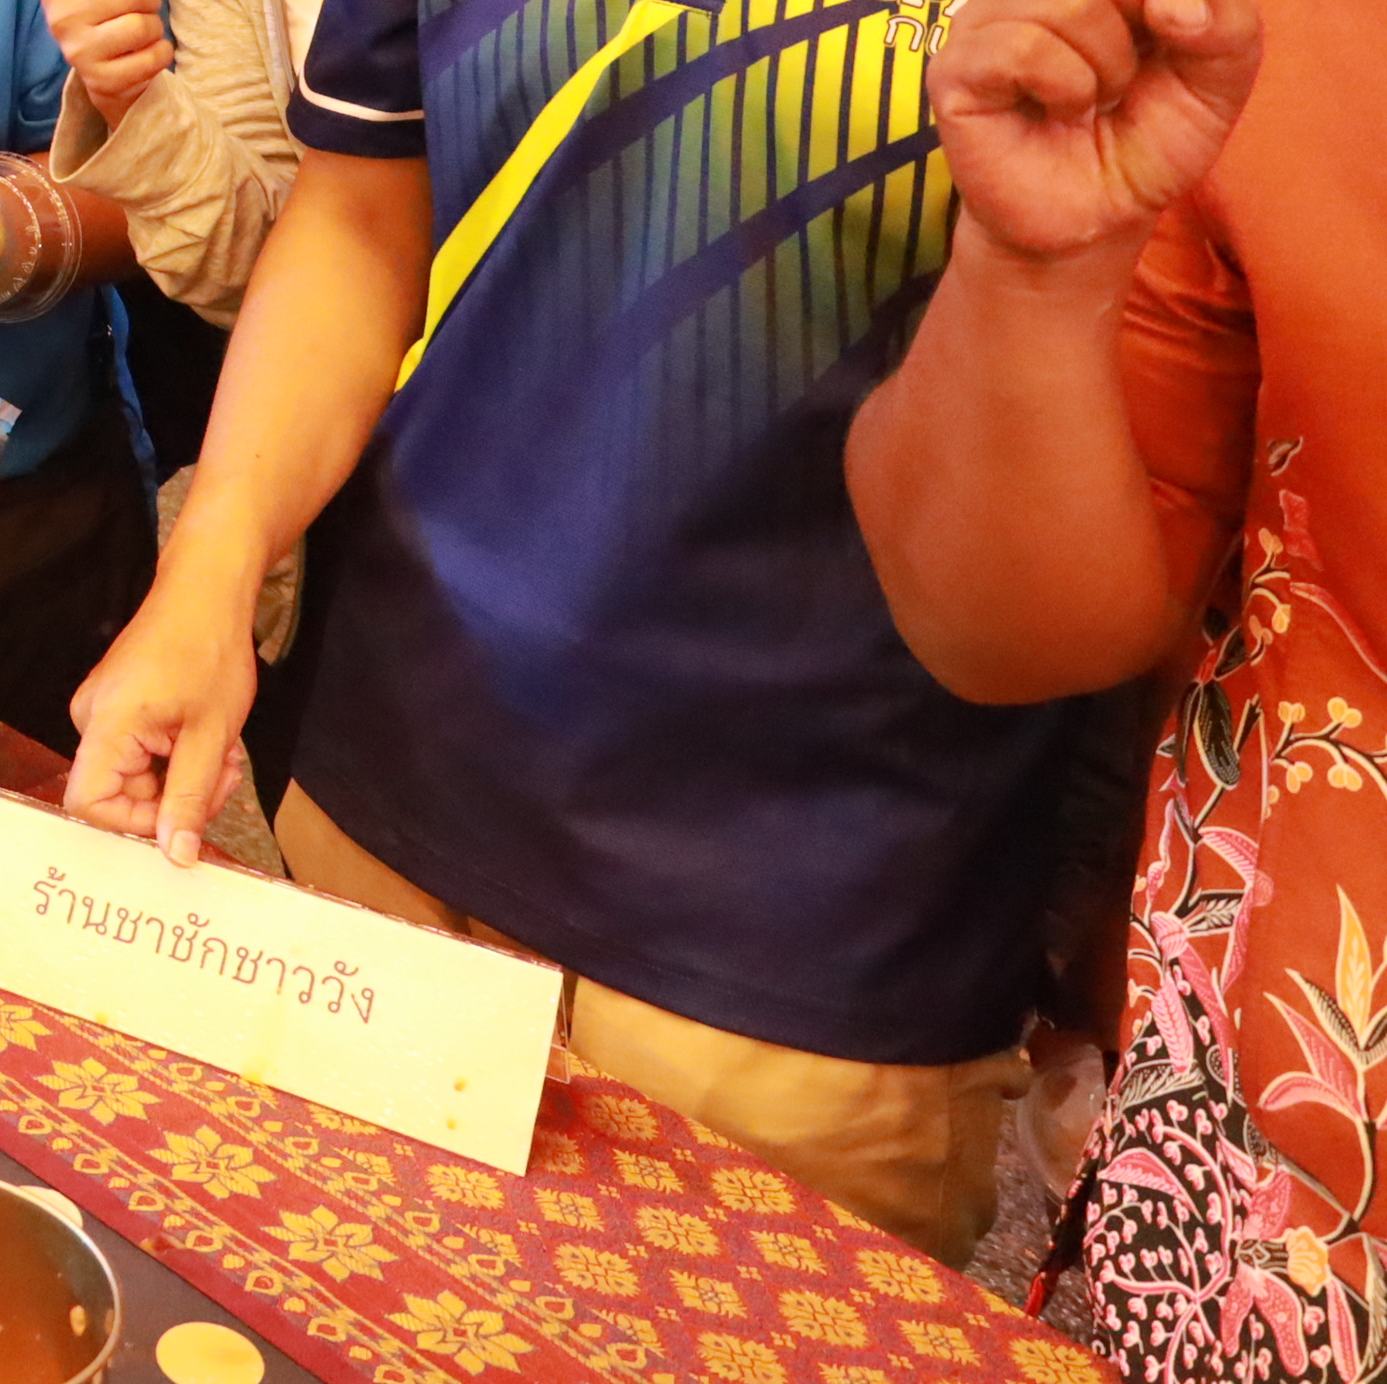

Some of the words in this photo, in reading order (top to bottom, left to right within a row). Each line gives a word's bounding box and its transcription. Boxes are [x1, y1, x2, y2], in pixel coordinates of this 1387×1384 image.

[31, 865, 377, 1025] ร้านชาชักชาววัง
